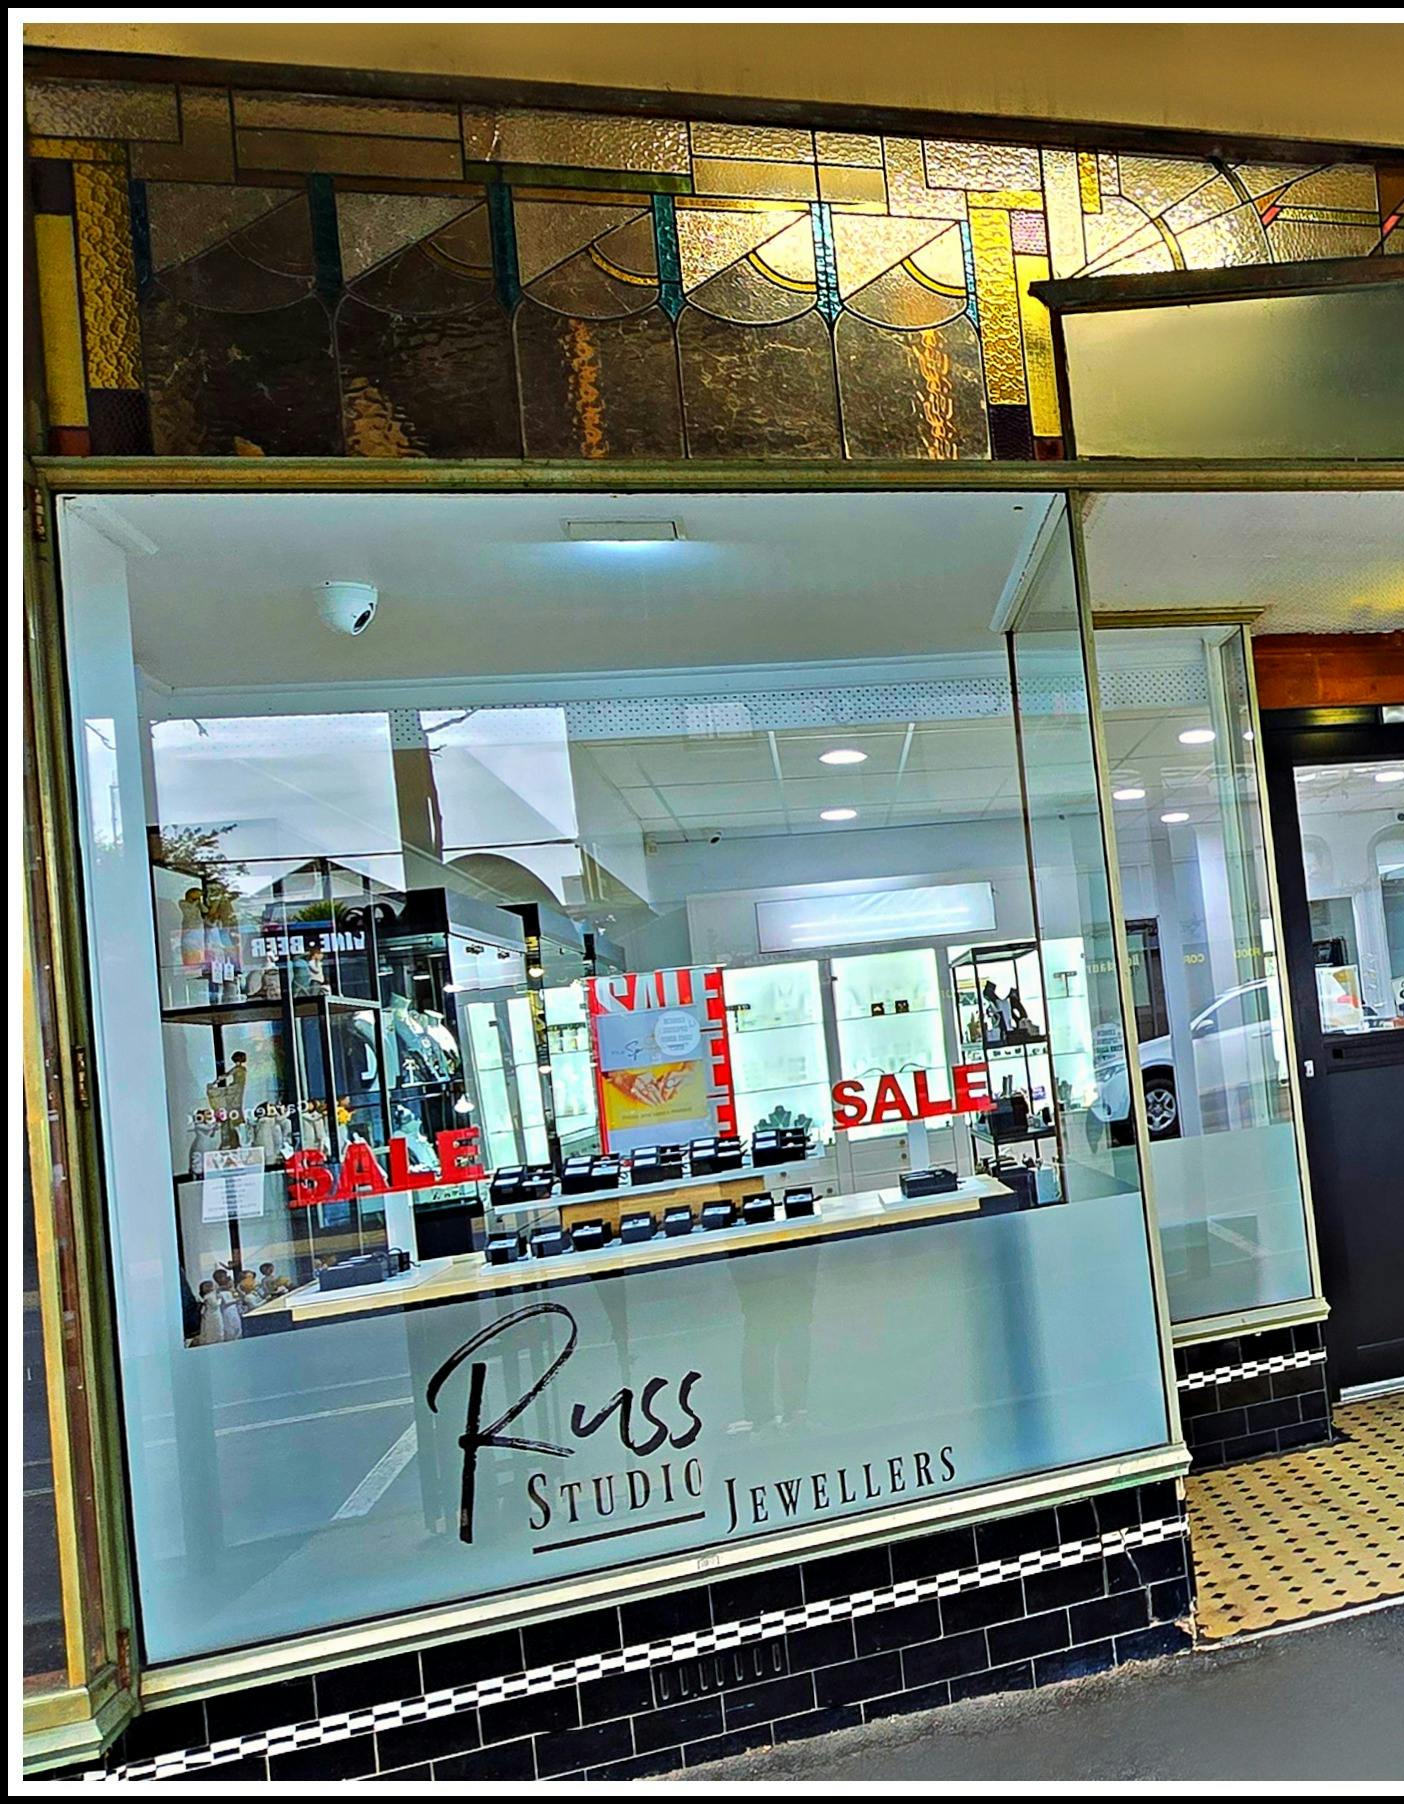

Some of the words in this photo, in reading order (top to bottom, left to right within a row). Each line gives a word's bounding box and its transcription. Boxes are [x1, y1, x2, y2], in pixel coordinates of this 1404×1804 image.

[832, 1063, 995, 1130] SALE
[285, 1127, 485, 1208] SALE
[426, 1302, 703, 1544] Russ
[528, 1458, 702, 1530] STUDIO
[724, 1446, 957, 1534] JEWELLERS
